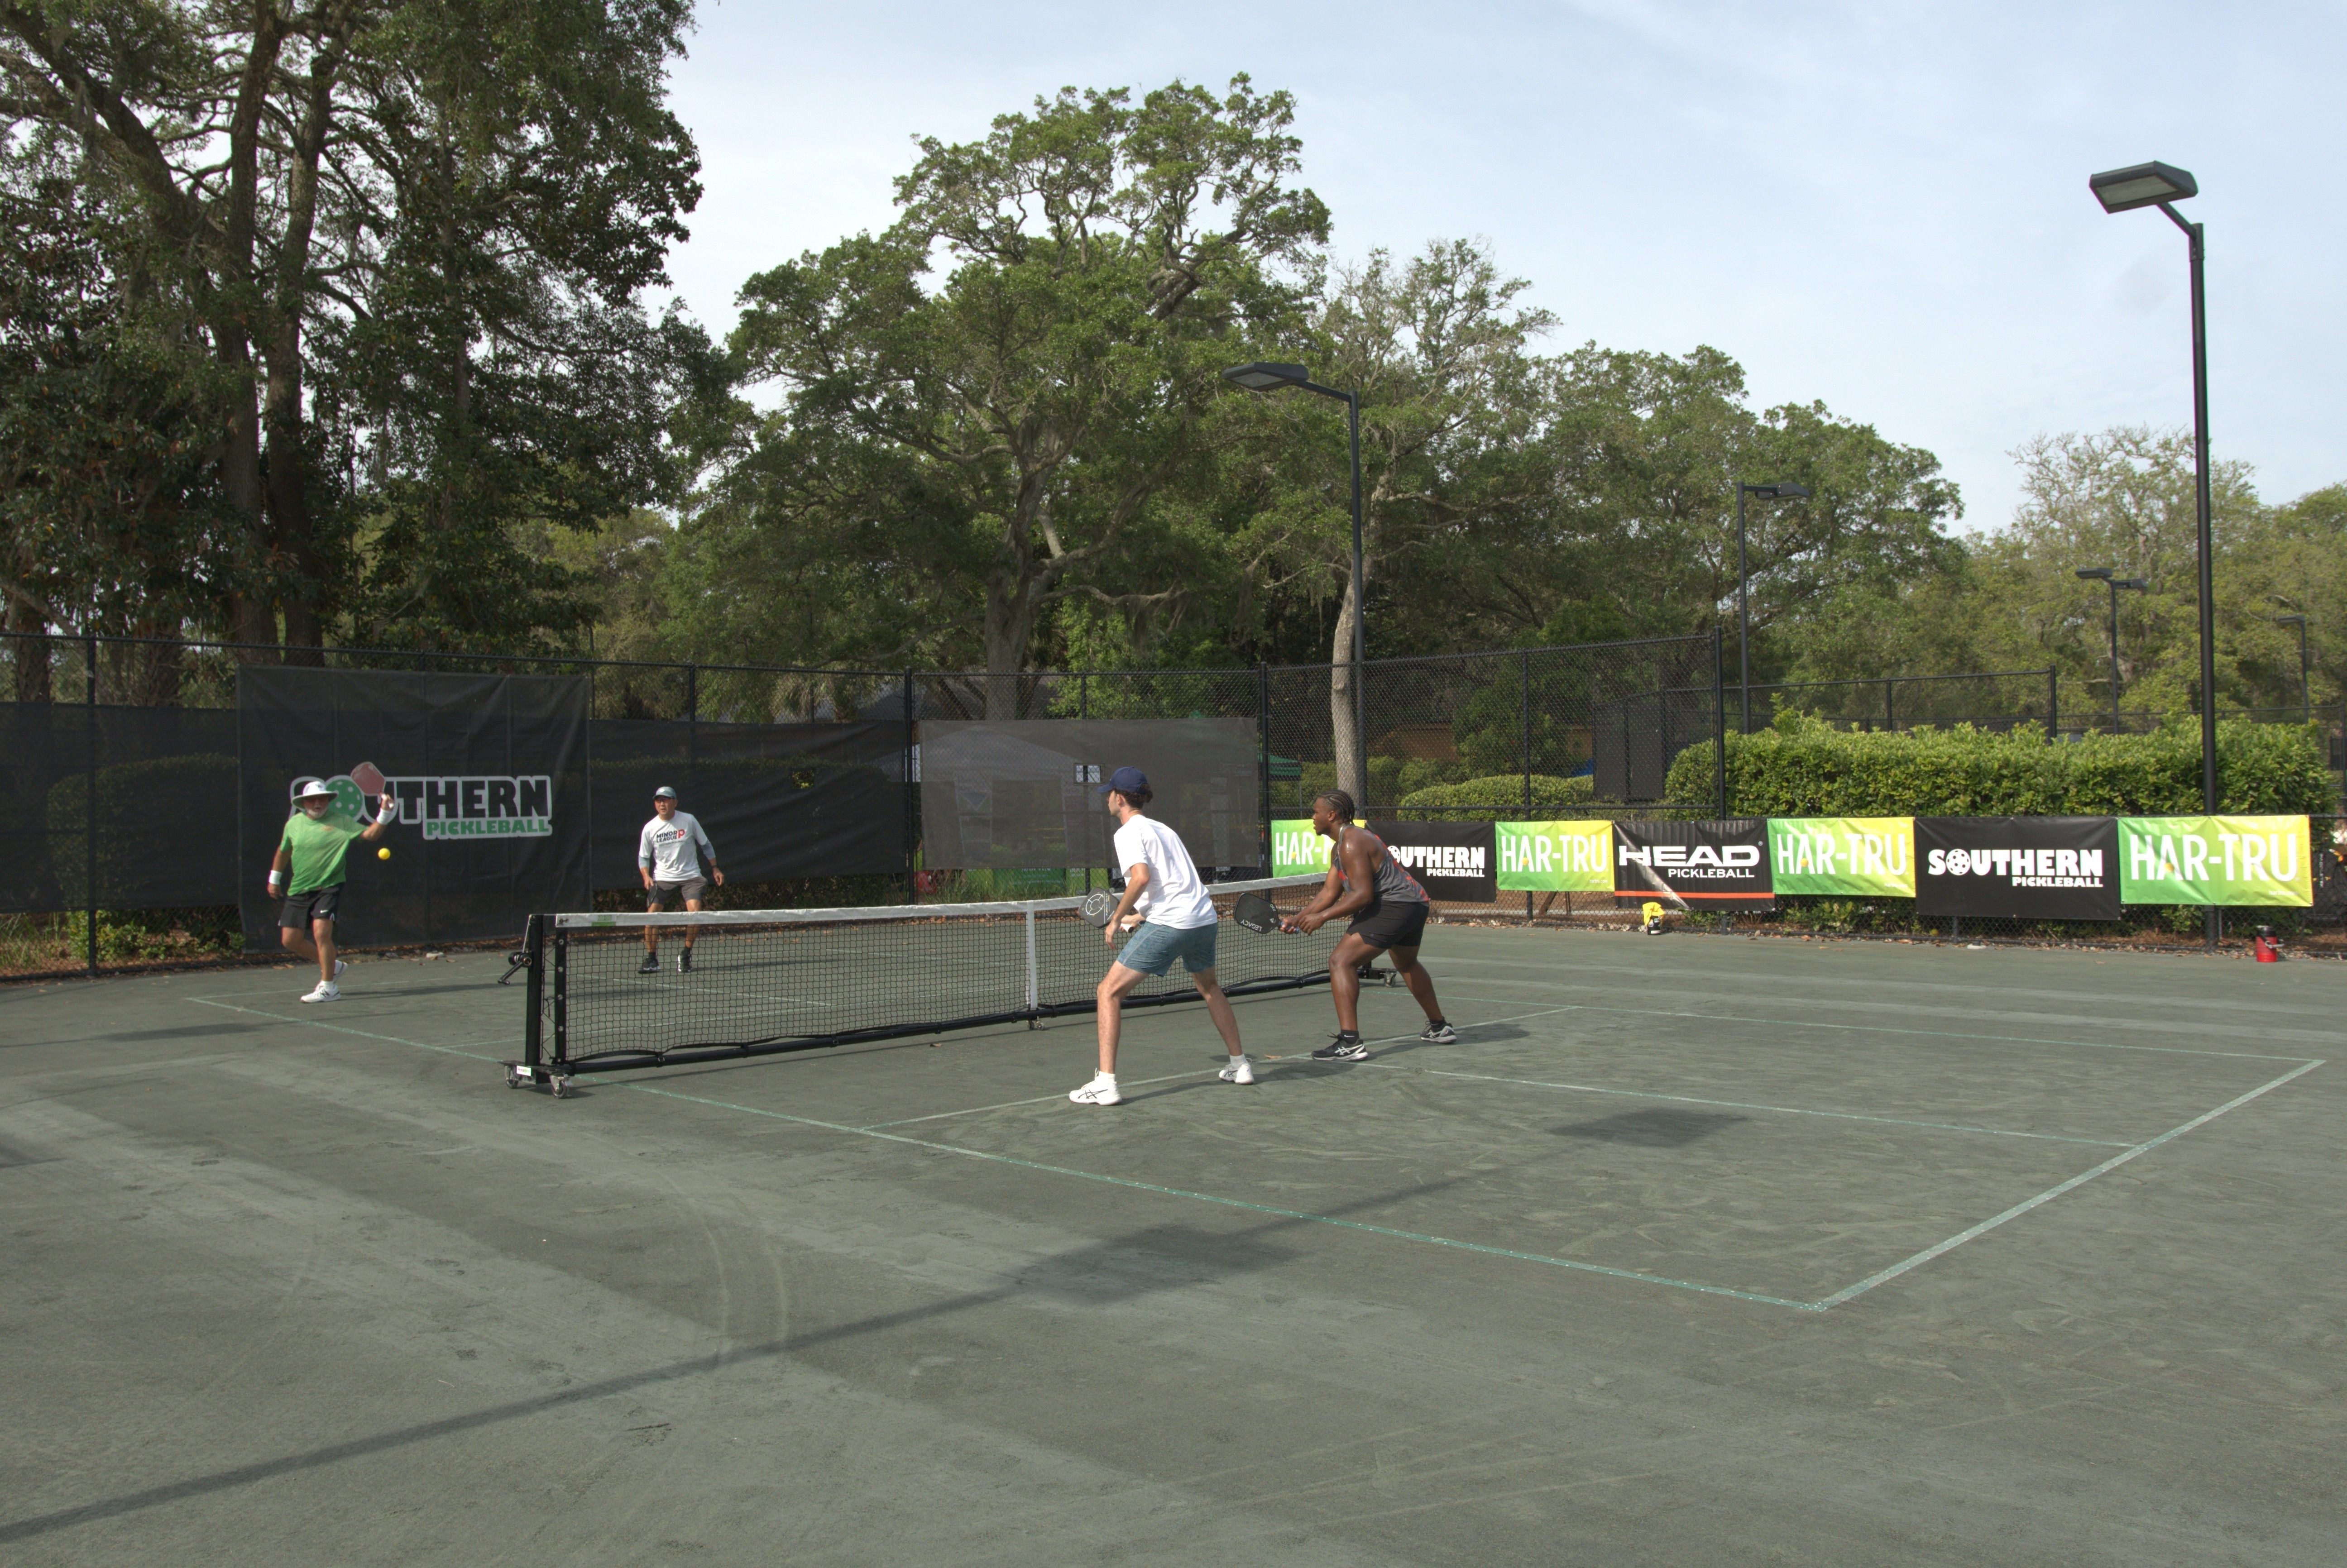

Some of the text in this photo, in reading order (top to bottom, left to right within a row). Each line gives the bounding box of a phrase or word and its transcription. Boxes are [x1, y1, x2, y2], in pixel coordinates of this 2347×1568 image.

[426, 819, 549, 836] PICKLEBALL
[656, 830, 677, 838] MINOR
[1275, 832, 1332, 865] HAR-T
[1501, 834, 1607, 872] HAR-TRU
[1619, 845, 1760, 867] HEAD
[1777, 833, 1907, 875] HAR-TRU
[2129, 833, 2297, 882] HAR-TRU
[1928, 848, 2103, 877] SOUTHERN
[1427, 868, 1485, 877] PICKLEBALL
[1668, 869, 1755, 878] PICKLEBALL
[2012, 876, 2103, 887] PICKLEBALL
[1241, 919, 1262, 932] LEGACY
